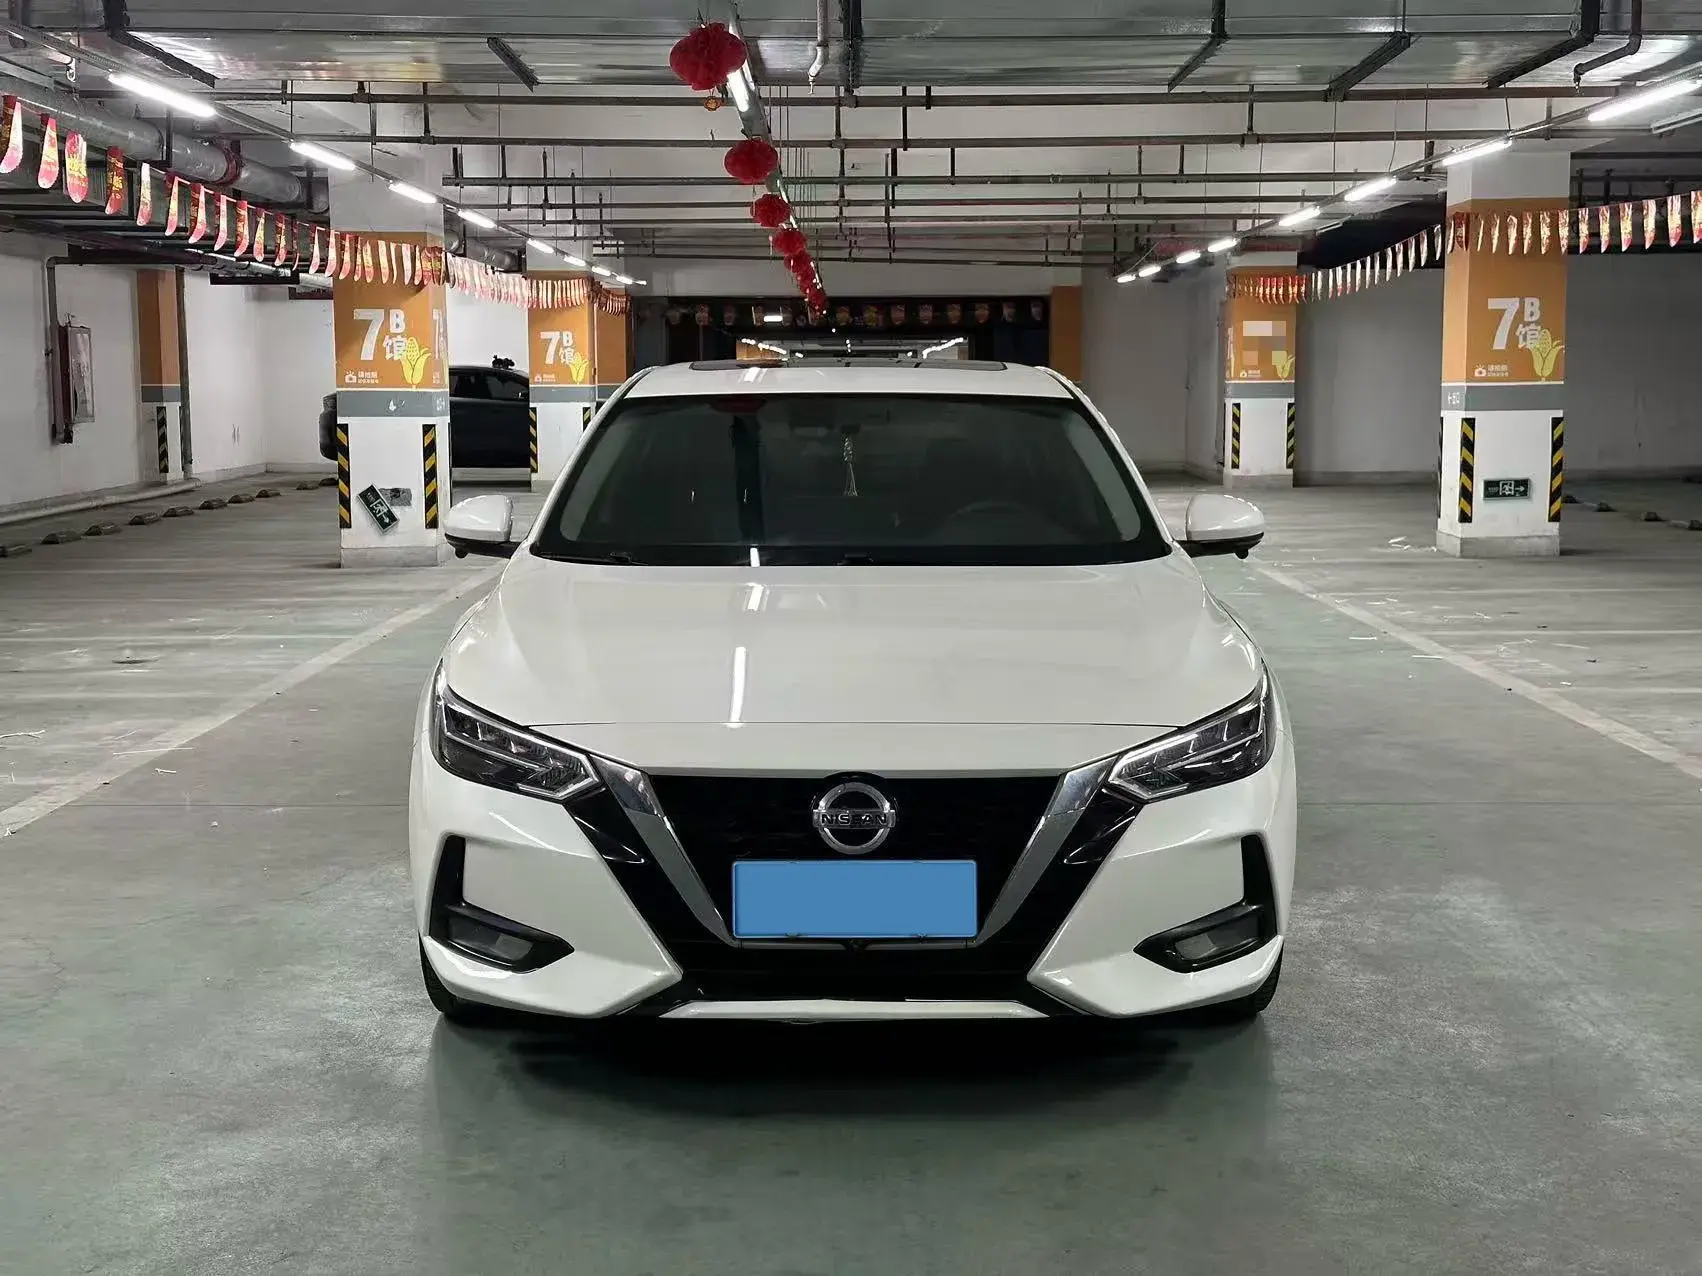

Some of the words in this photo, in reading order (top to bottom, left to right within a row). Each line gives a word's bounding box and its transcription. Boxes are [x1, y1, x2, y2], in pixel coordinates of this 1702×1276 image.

[389, 309, 406, 334] B
[1524, 297, 1541, 322] B
[353, 308, 385, 361] 7
[1487, 297, 1520, 350] 7
[383, 334, 407, 361] 馆
[540, 331, 561, 365] 7
[562, 331, 574, 347] B
